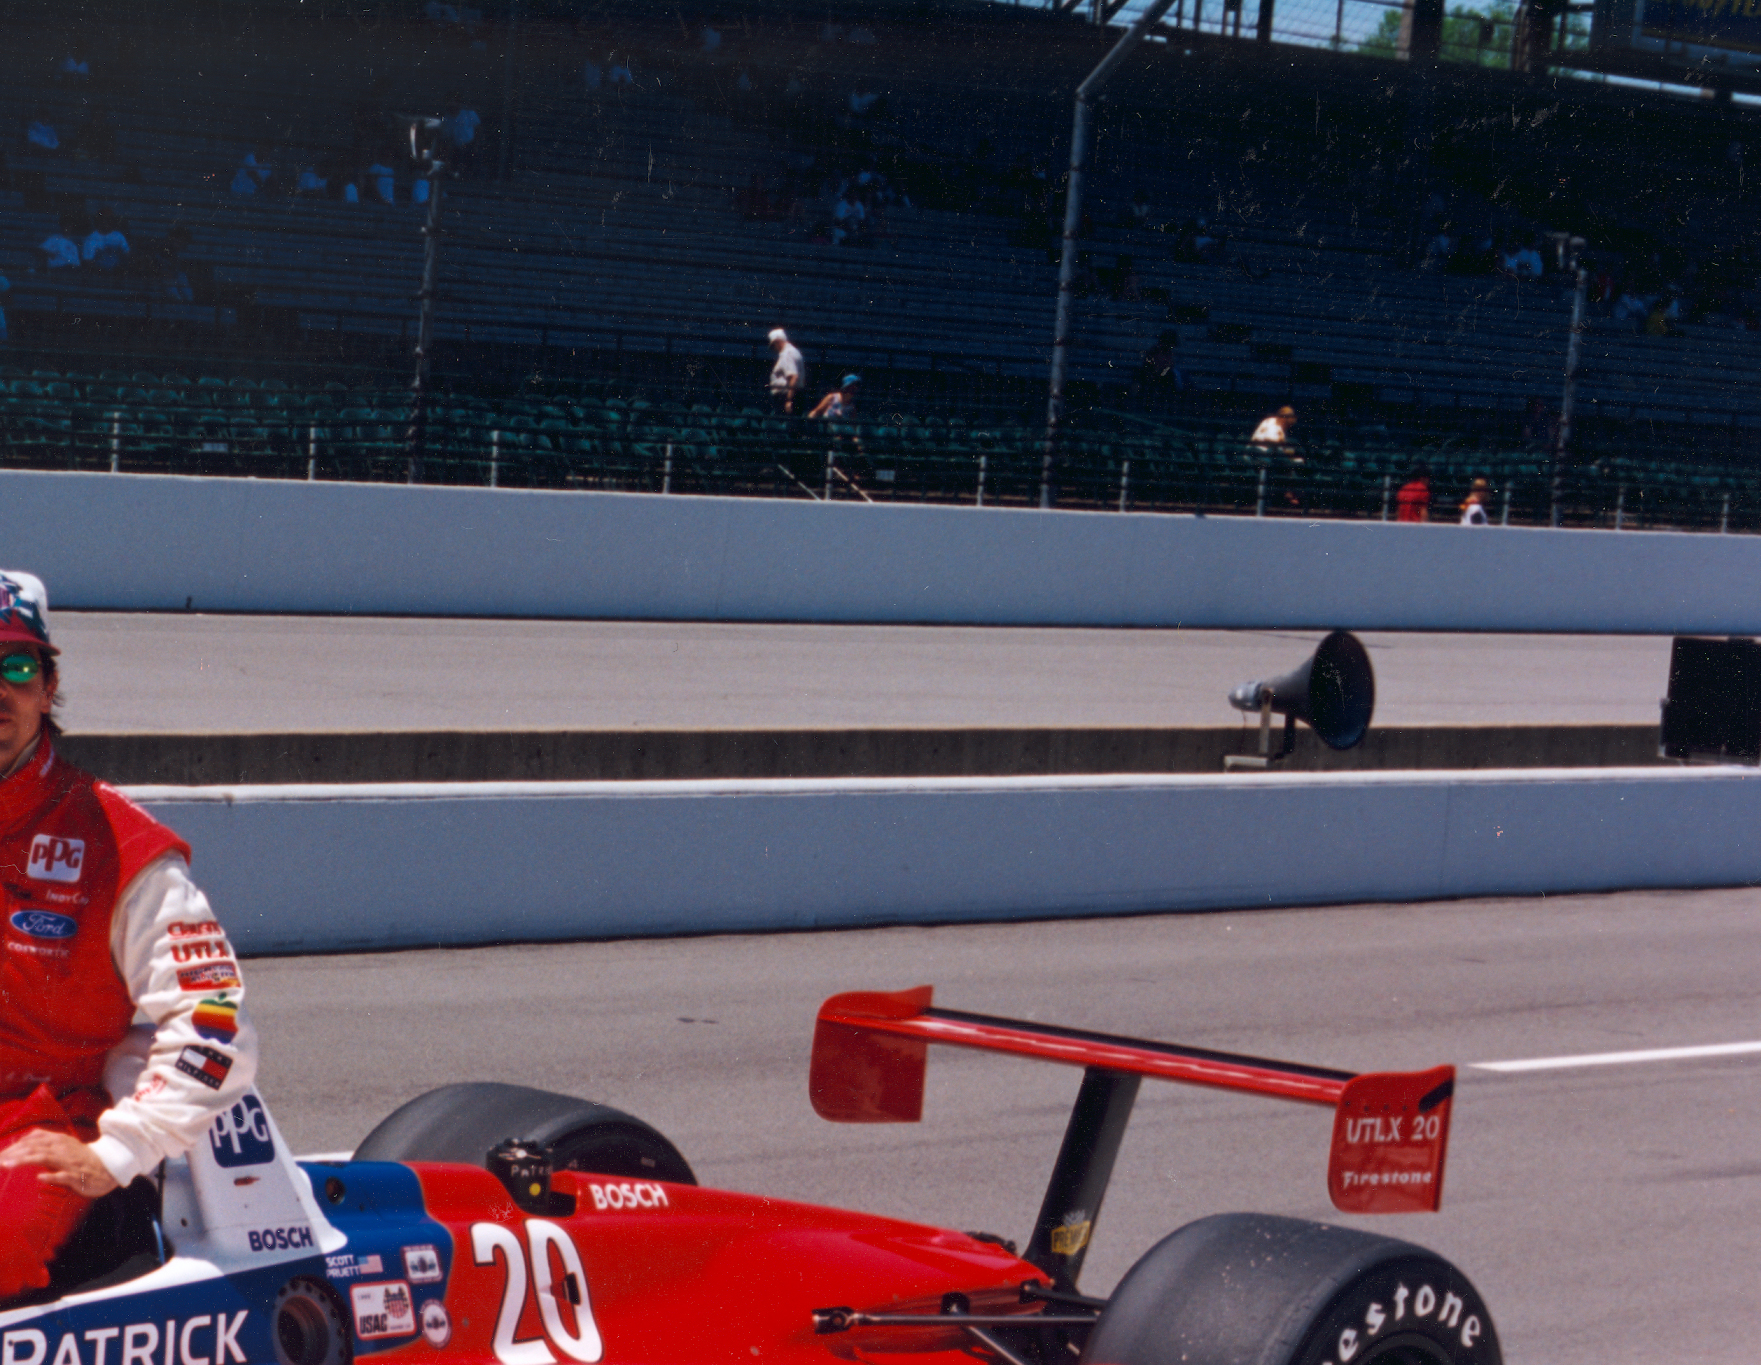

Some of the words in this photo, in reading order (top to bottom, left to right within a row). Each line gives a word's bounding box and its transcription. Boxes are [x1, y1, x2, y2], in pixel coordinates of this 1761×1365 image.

[31, 837, 82, 873] PPG
[22, 912, 66, 935] Ford
[212, 1099, 269, 1154] PPG
[1347, 1116, 1402, 1143] UTLX
[1411, 1115, 1439, 1141] 20
[1343, 1170, 1432, 1190] Firestone
[589, 1183, 669, 1210] BOSCH
[248, 1226, 314, 1252] BOSCH
[325, 1254, 354, 1268] SCOTT
[326, 1265, 360, 1279] PRUETT
[360, 1313, 388, 1334] USAC
